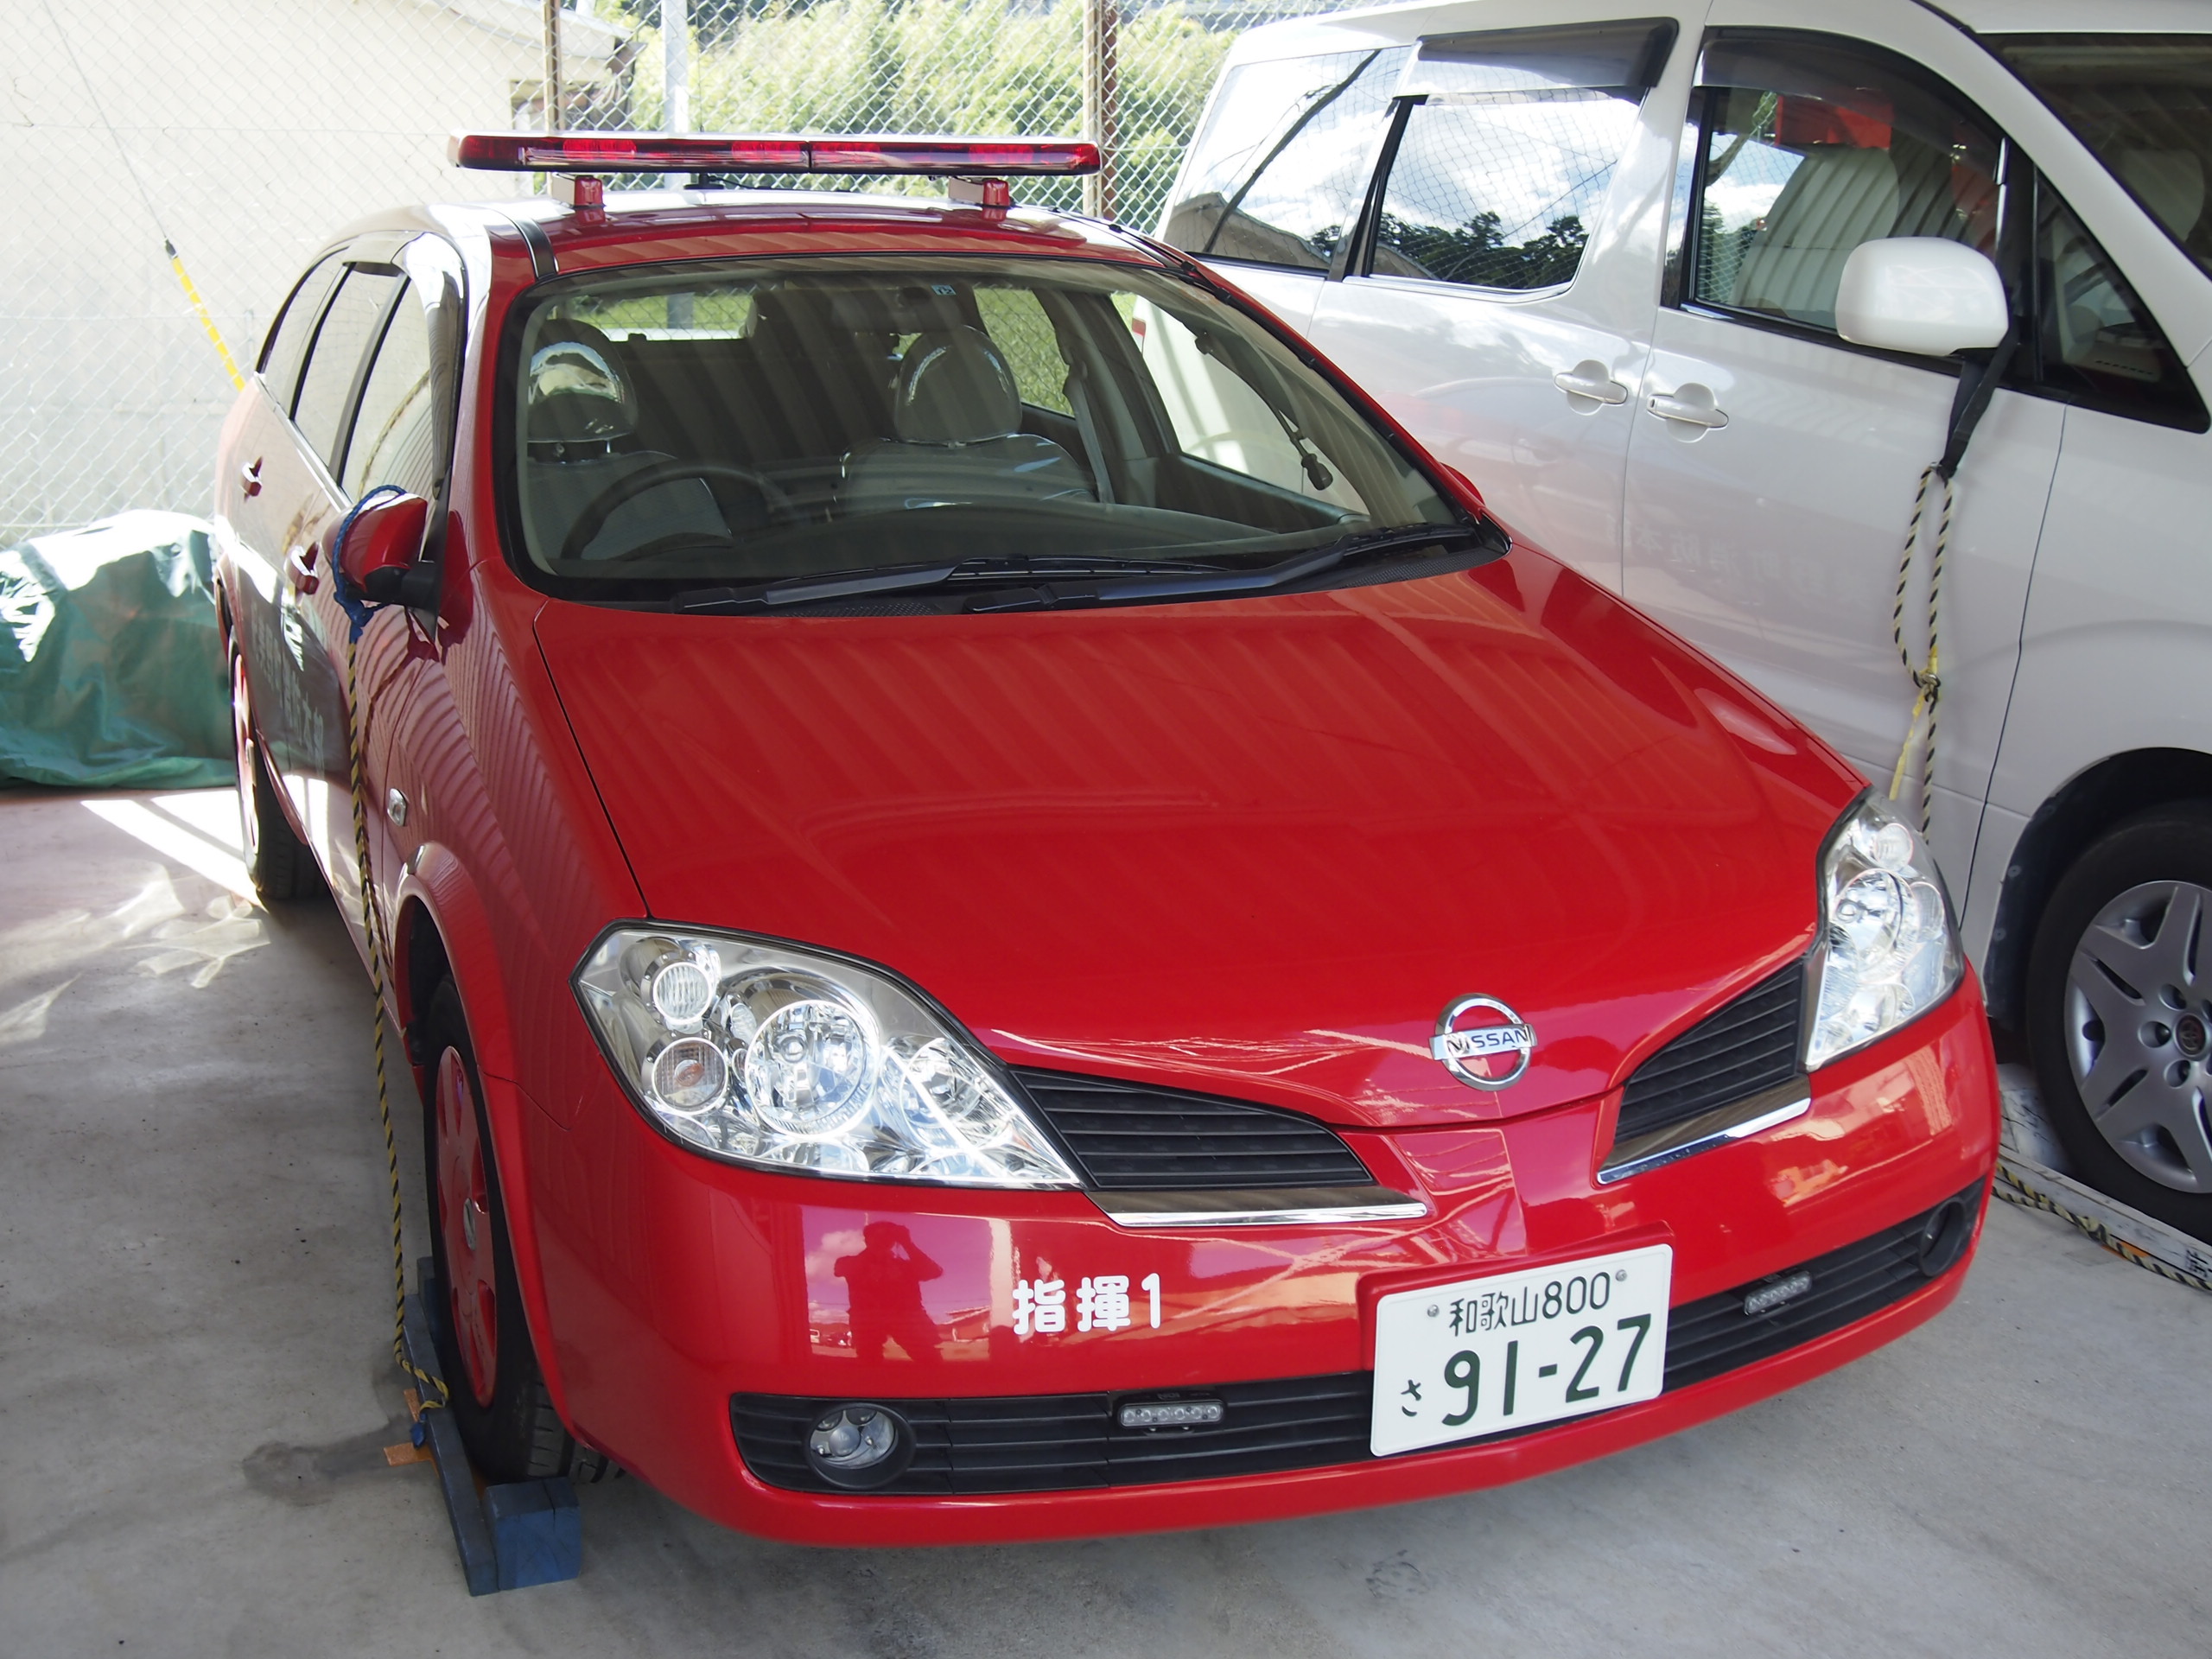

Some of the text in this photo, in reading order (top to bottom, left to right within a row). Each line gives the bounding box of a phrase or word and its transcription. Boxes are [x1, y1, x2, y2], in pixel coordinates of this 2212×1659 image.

[1446, 1025, 1531, 1054] NISSAN
[1400, 1313, 1652, 1427] さ 91-27
